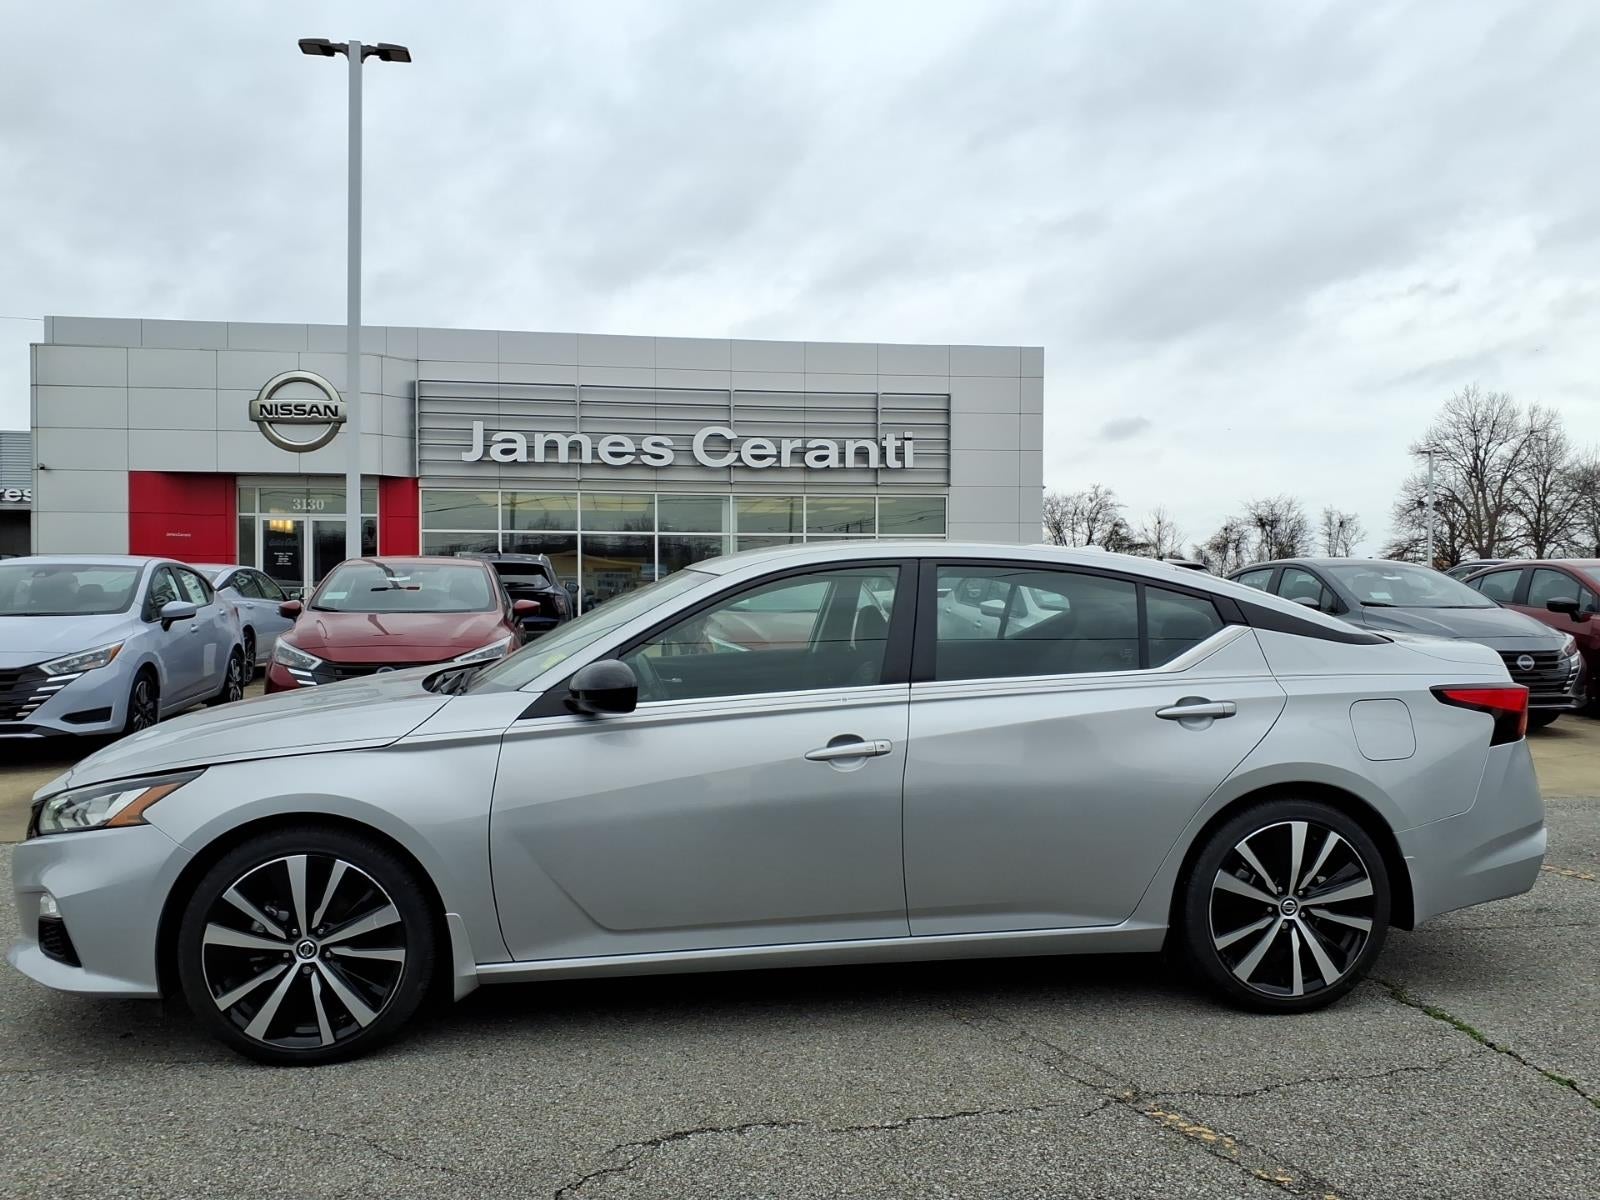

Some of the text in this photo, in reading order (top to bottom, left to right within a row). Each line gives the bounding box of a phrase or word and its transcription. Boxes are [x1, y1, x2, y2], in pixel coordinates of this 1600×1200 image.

[259, 404, 338, 417] NISSAN
[461, 420, 914, 469] James Ceranti
[292, 498, 324, 510] 3130
